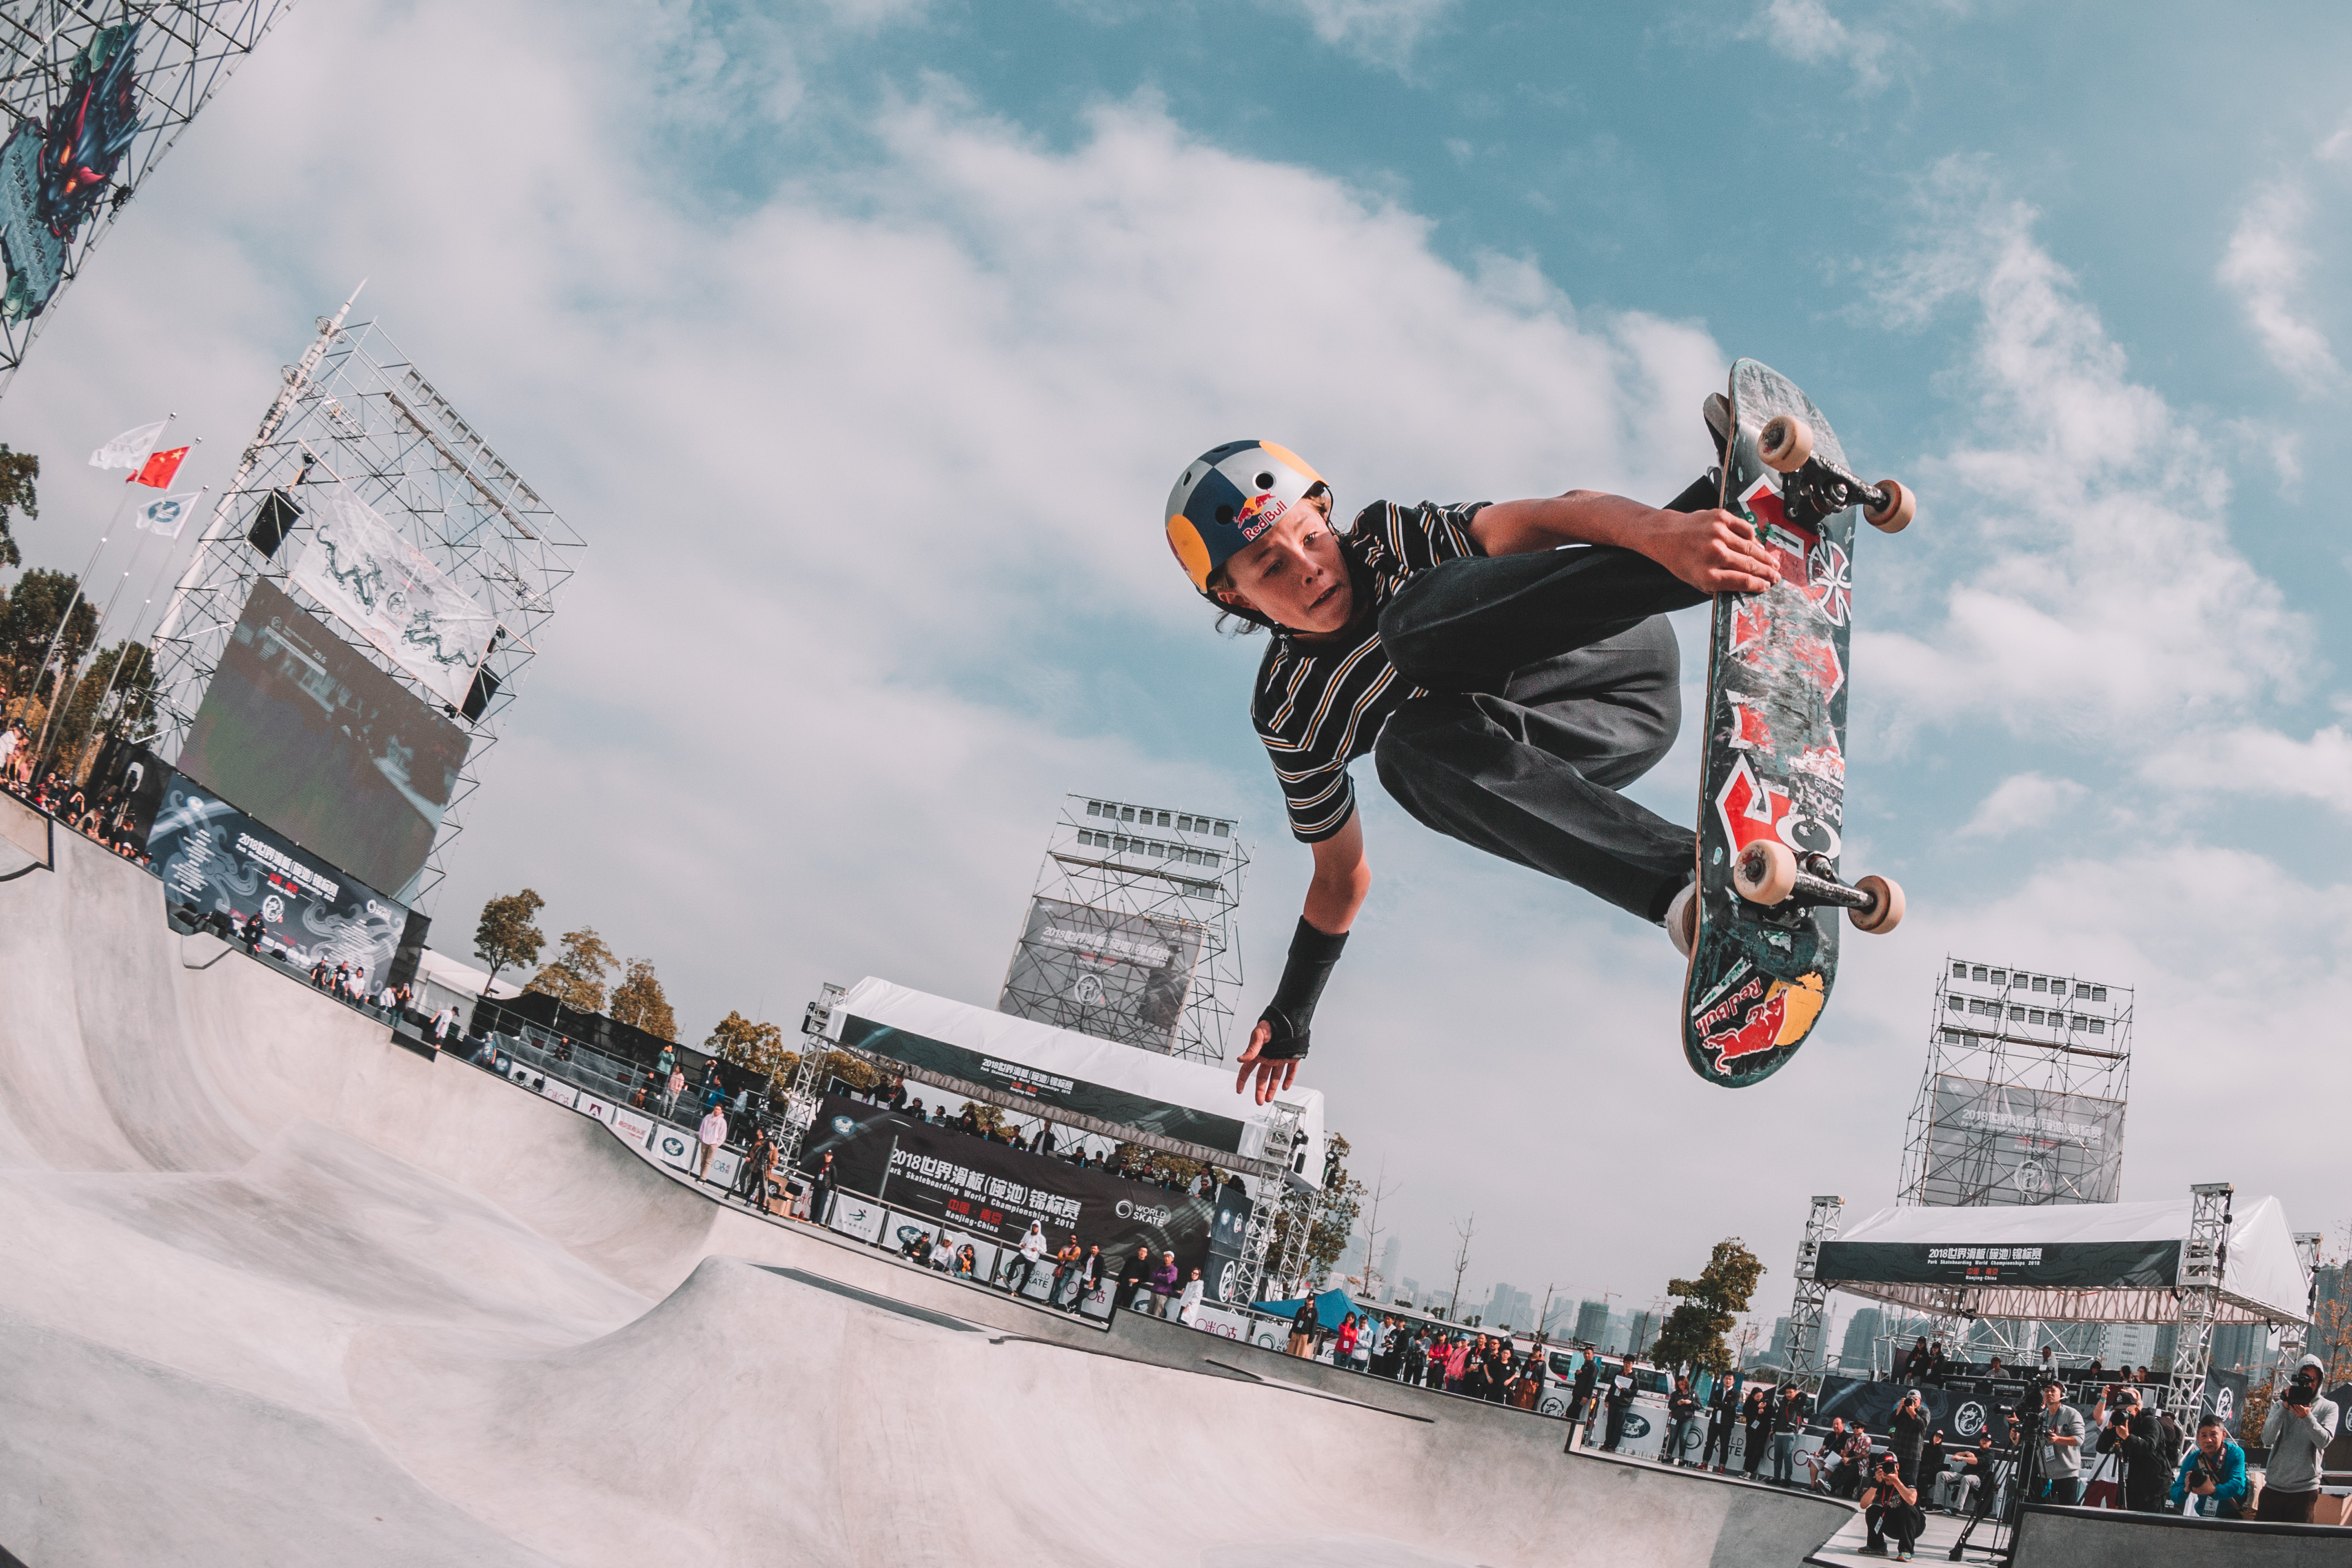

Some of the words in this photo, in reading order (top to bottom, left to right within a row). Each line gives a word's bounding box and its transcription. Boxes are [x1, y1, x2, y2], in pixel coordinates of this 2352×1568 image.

[1243, 515, 1269, 542] Red
[1263, 500, 1287, 522] Bull
[1814, 778, 1843, 802] mobile
[1728, 977, 1763, 1016] Red
[1695, 1000, 1729, 1037] Bull
[889, 1167, 902, 1176] ark
[906, 1171, 959, 1195] Skateboarding
[964, 1190, 986, 1203] World
[990, 1198, 1050, 1222] Championships
[1054, 1214, 1075, 1230] 2018
[1133, 1212, 1165, 1227] SKATE
[1136, 1205, 1166, 1218] WORLD
[1022, 1274, 1049, 1289] KATE
[1030, 1269, 1050, 1281] ORLD
